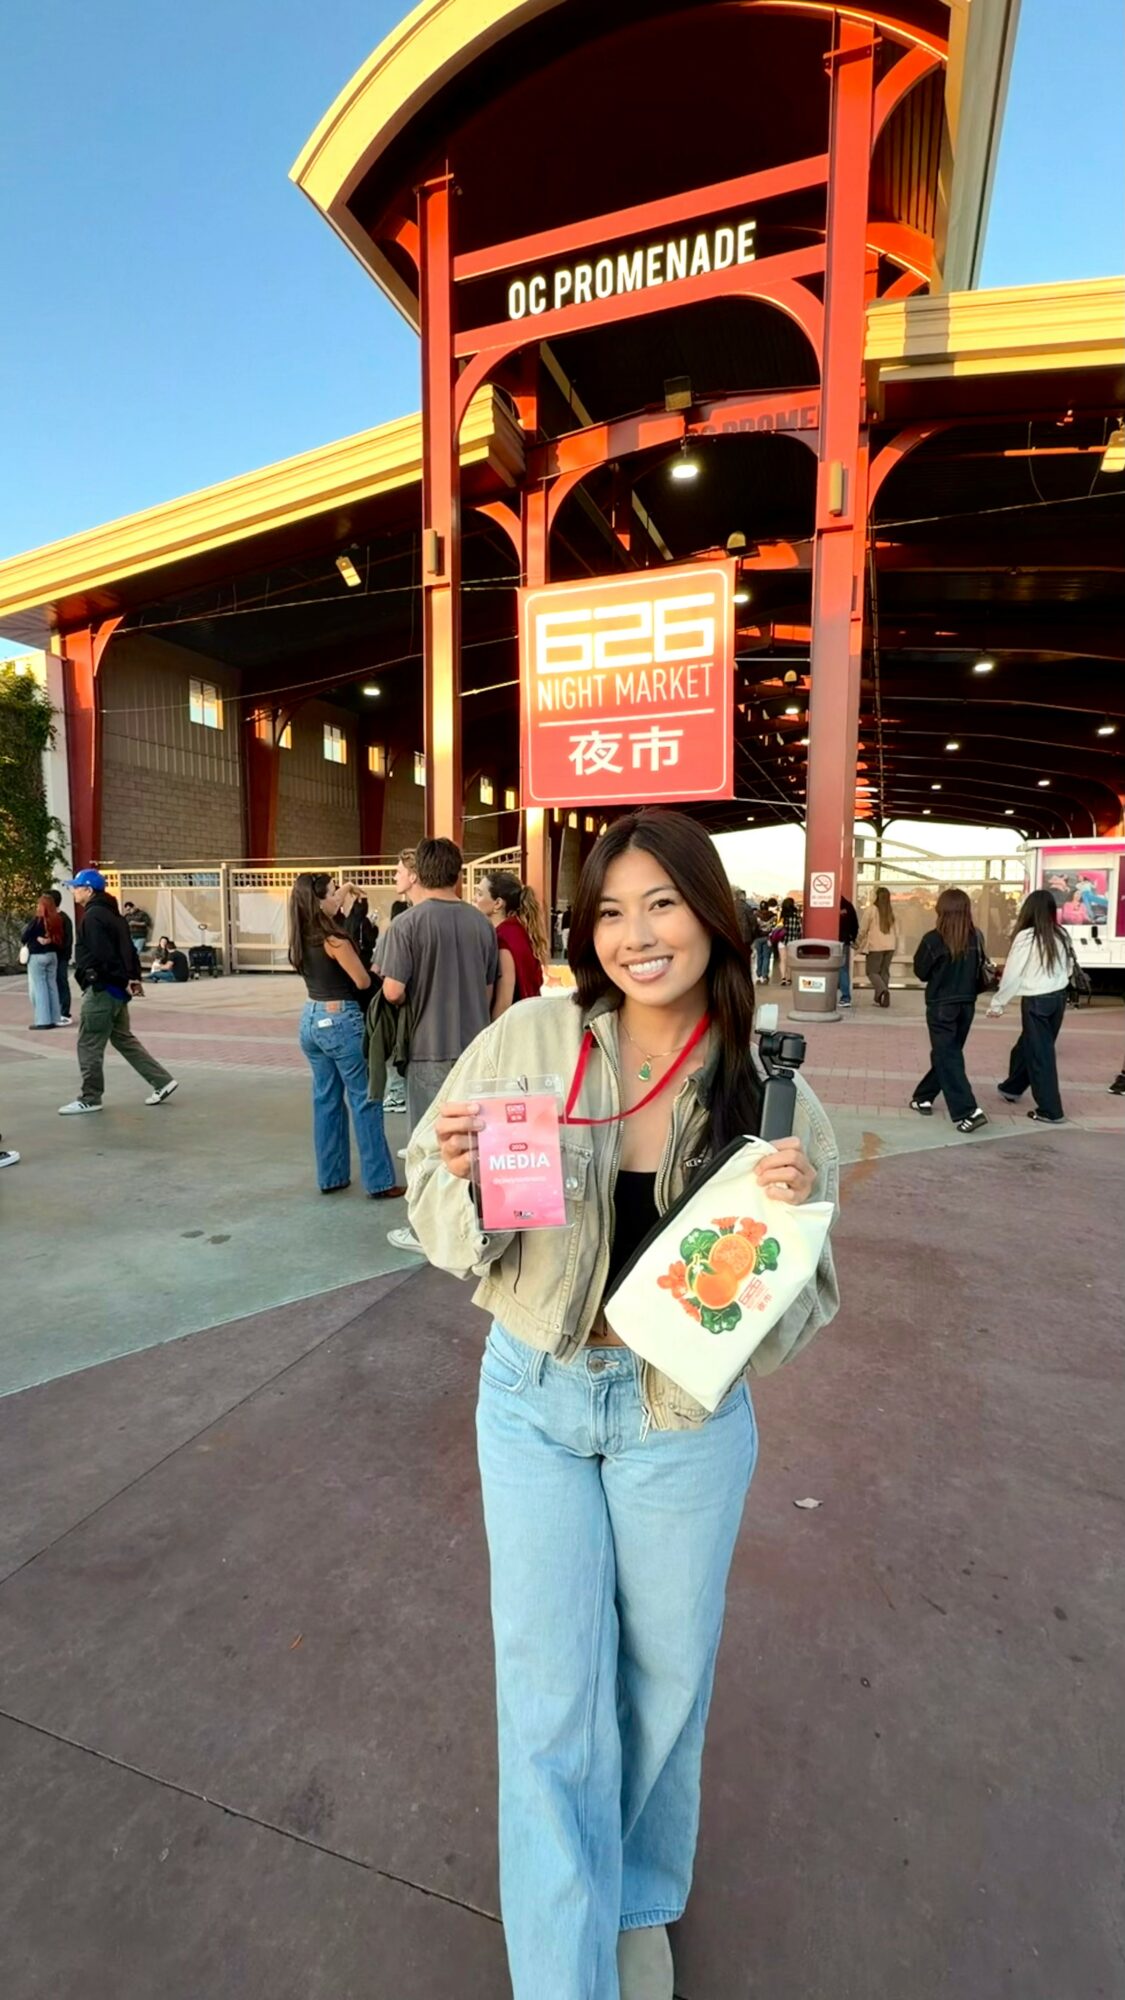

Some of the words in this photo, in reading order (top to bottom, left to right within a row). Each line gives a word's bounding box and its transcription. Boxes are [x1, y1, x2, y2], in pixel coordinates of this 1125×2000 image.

[507, 275, 547, 320] OC
[554, 221, 757, 309] PROMENADE
[536, 593, 714, 674] 626
[538, 674, 607, 711] NIGHT
[615, 662, 714, 706] MARKET
[568, 725, 684, 776] 夜市
[490, 1152, 550, 1170] MEDIA
